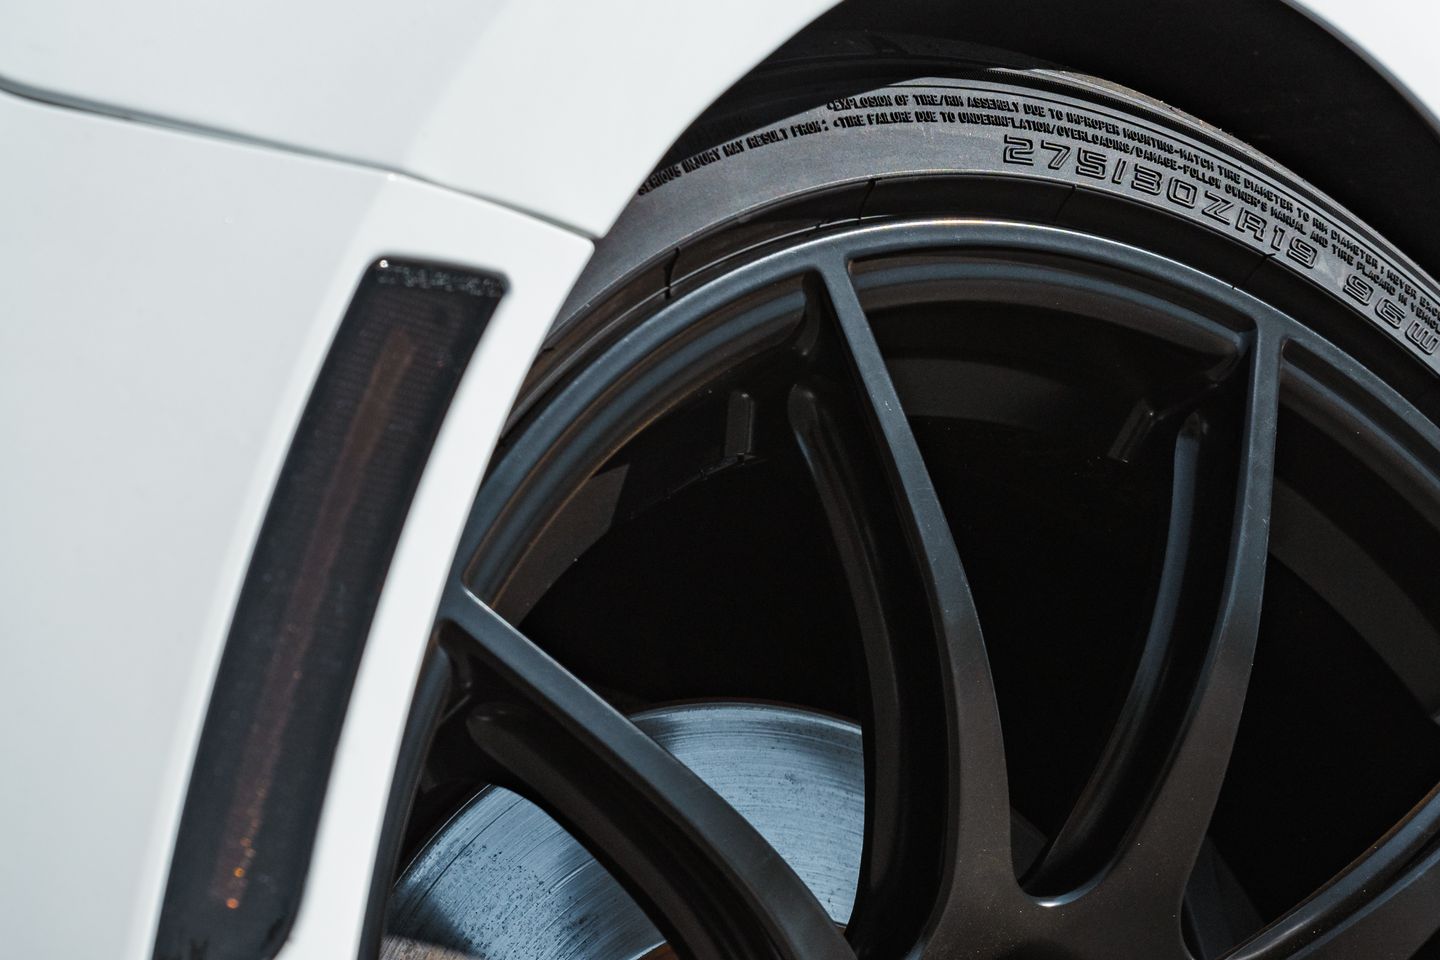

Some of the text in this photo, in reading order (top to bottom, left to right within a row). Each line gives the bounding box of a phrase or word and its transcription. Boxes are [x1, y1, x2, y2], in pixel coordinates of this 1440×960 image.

[636, 162, 682, 196] SERIOUS
[679, 147, 720, 173] INJURY
[722, 139, 744, 157] MAY
[746, 128, 788, 149] RESULT
[838, 114, 866, 128] TIRE
[866, 111, 913, 124] FAILURE
[914, 110, 937, 122] DUE
[939, 111, 955, 122] TO
[1224, 183, 1267, 212] OWNER'S
[1270, 206, 1306, 235] MANUAL
[1309, 230, 1328, 248] AND
[1331, 243, 1354, 266] TIRE
[1355, 260, 1395, 296] PLACARD
[1397, 292, 1407, 306] IN
[831, 94, 893, 111] EXPLOSION
[893, 94, 908, 106] OF
[967, 96, 1019, 113] ASSEMBLY
[1022, 103, 1045, 117] DUE
[1047, 107, 1063, 120] TO
[1065, 111, 1120, 136] IMPROPER
[1216, 164, 1240, 184] TIRE
[1243, 177, 1293, 213] DIAMETER
[1296, 207, 1309, 222] TO
[1312, 217, 1327, 235] RIM
[1386, 269, 1416, 300] NEVER
[1003, 134, 1440, 356] 275/30ZR19 96W
